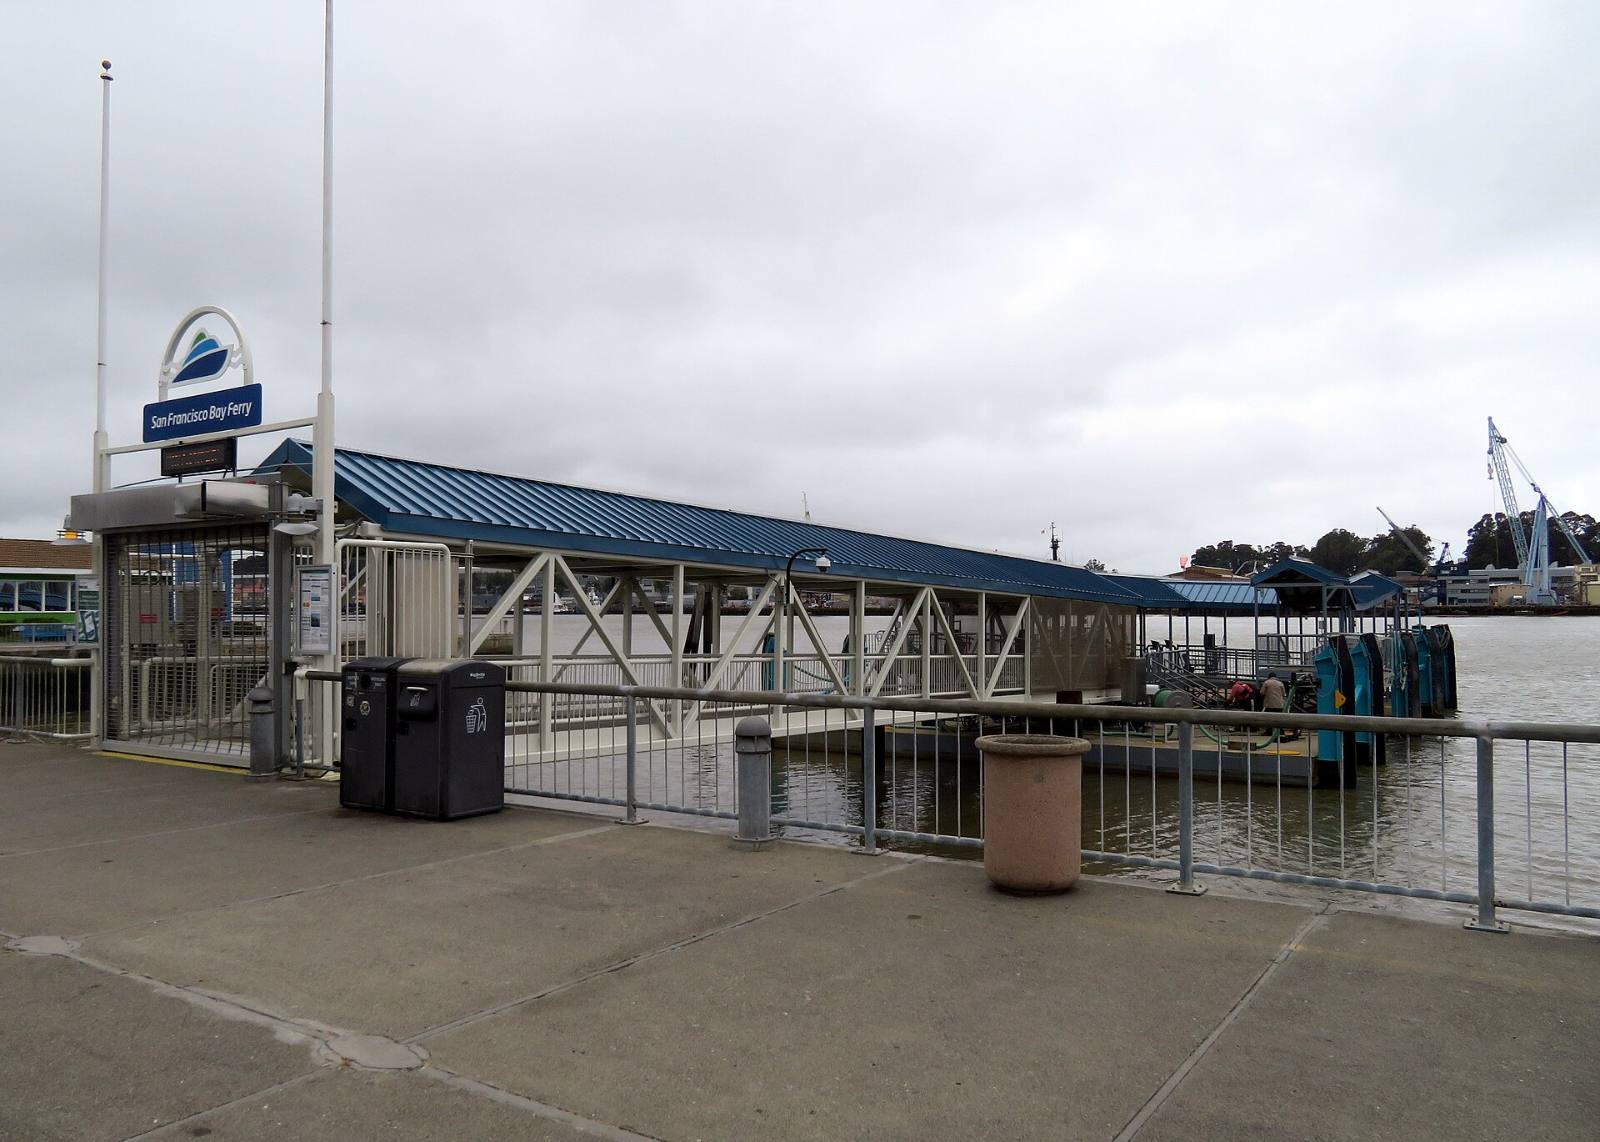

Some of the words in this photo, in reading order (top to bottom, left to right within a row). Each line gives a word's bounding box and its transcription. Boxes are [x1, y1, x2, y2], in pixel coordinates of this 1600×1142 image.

[151, 415, 167, 429] San
[167, 409, 208, 427] Francisco
[209, 405, 227, 421] Bay
[227, 402, 253, 417] Ferry
